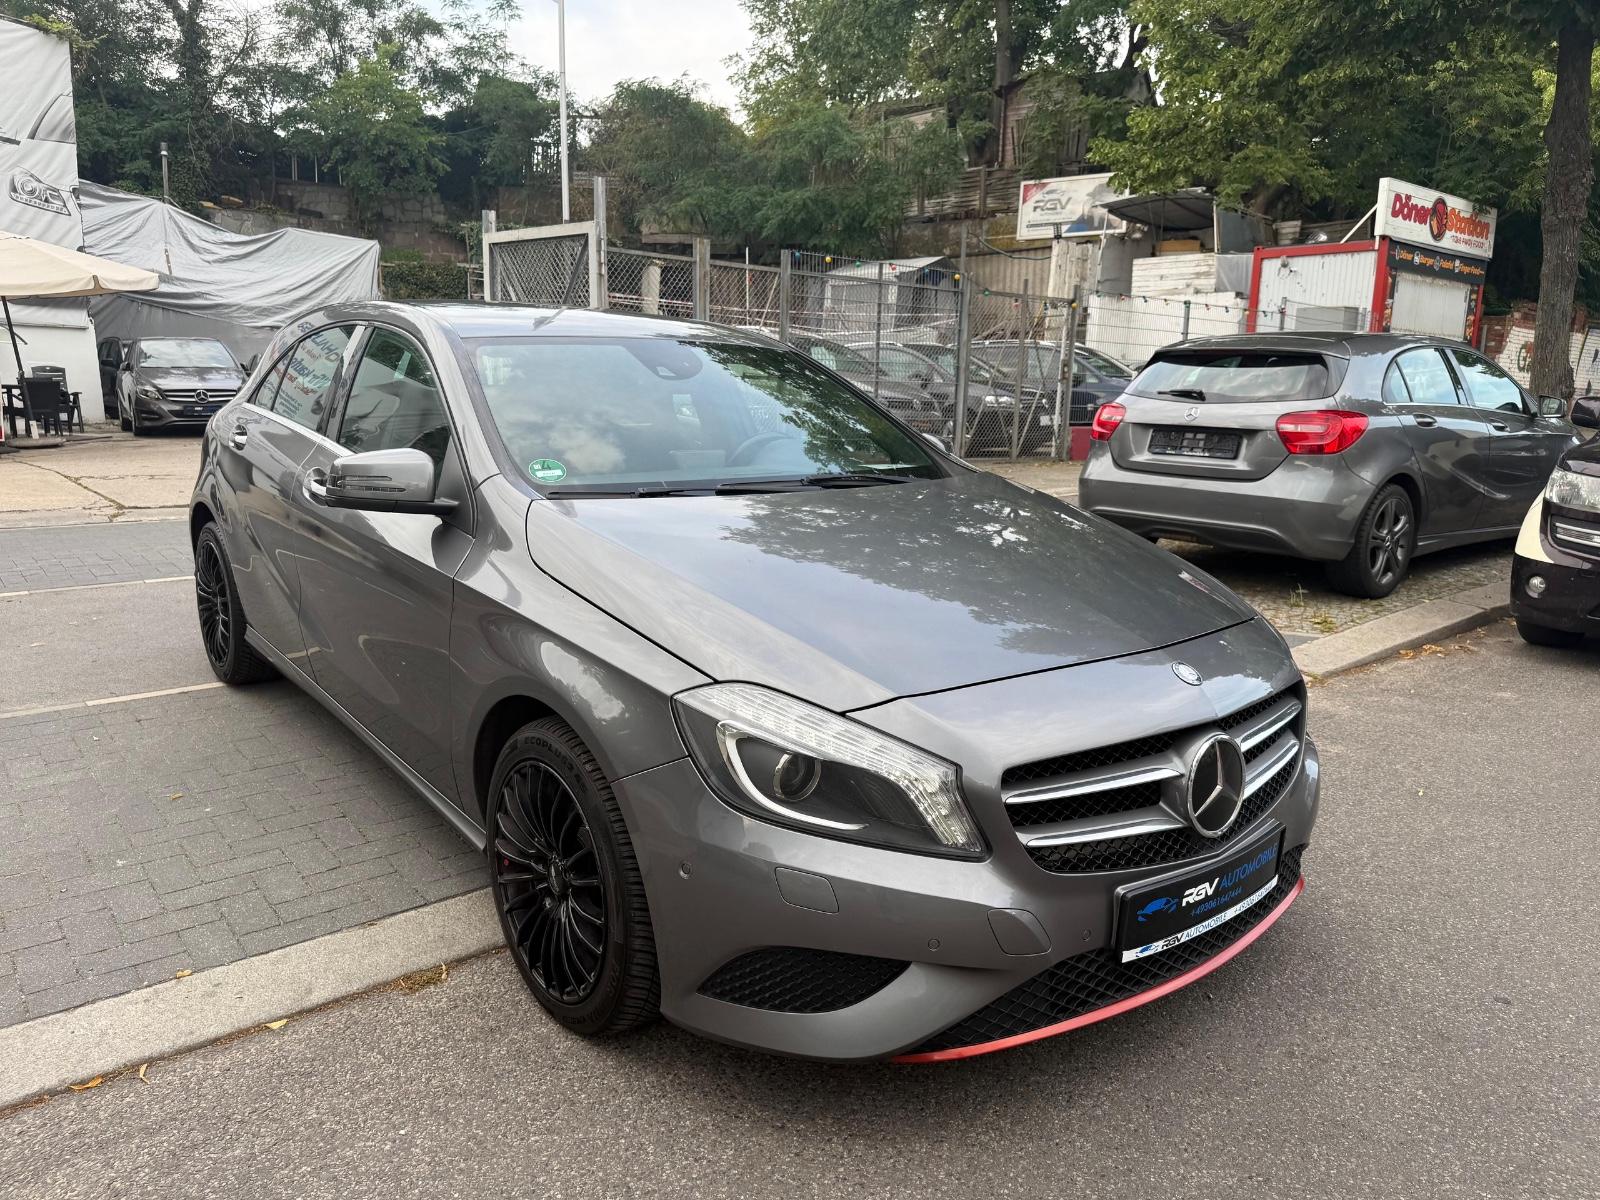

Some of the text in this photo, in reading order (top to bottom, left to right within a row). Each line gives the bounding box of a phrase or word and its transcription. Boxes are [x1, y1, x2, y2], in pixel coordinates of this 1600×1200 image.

[1033, 197, 1072, 212] RGV
[1391, 193, 1490, 240] Döner Station
[1181, 843, 1278, 907] RGV AUTOMOBILE
[1161, 932, 1184, 949] RGV
[1184, 912, 1227, 939] AUTOMOBILE
